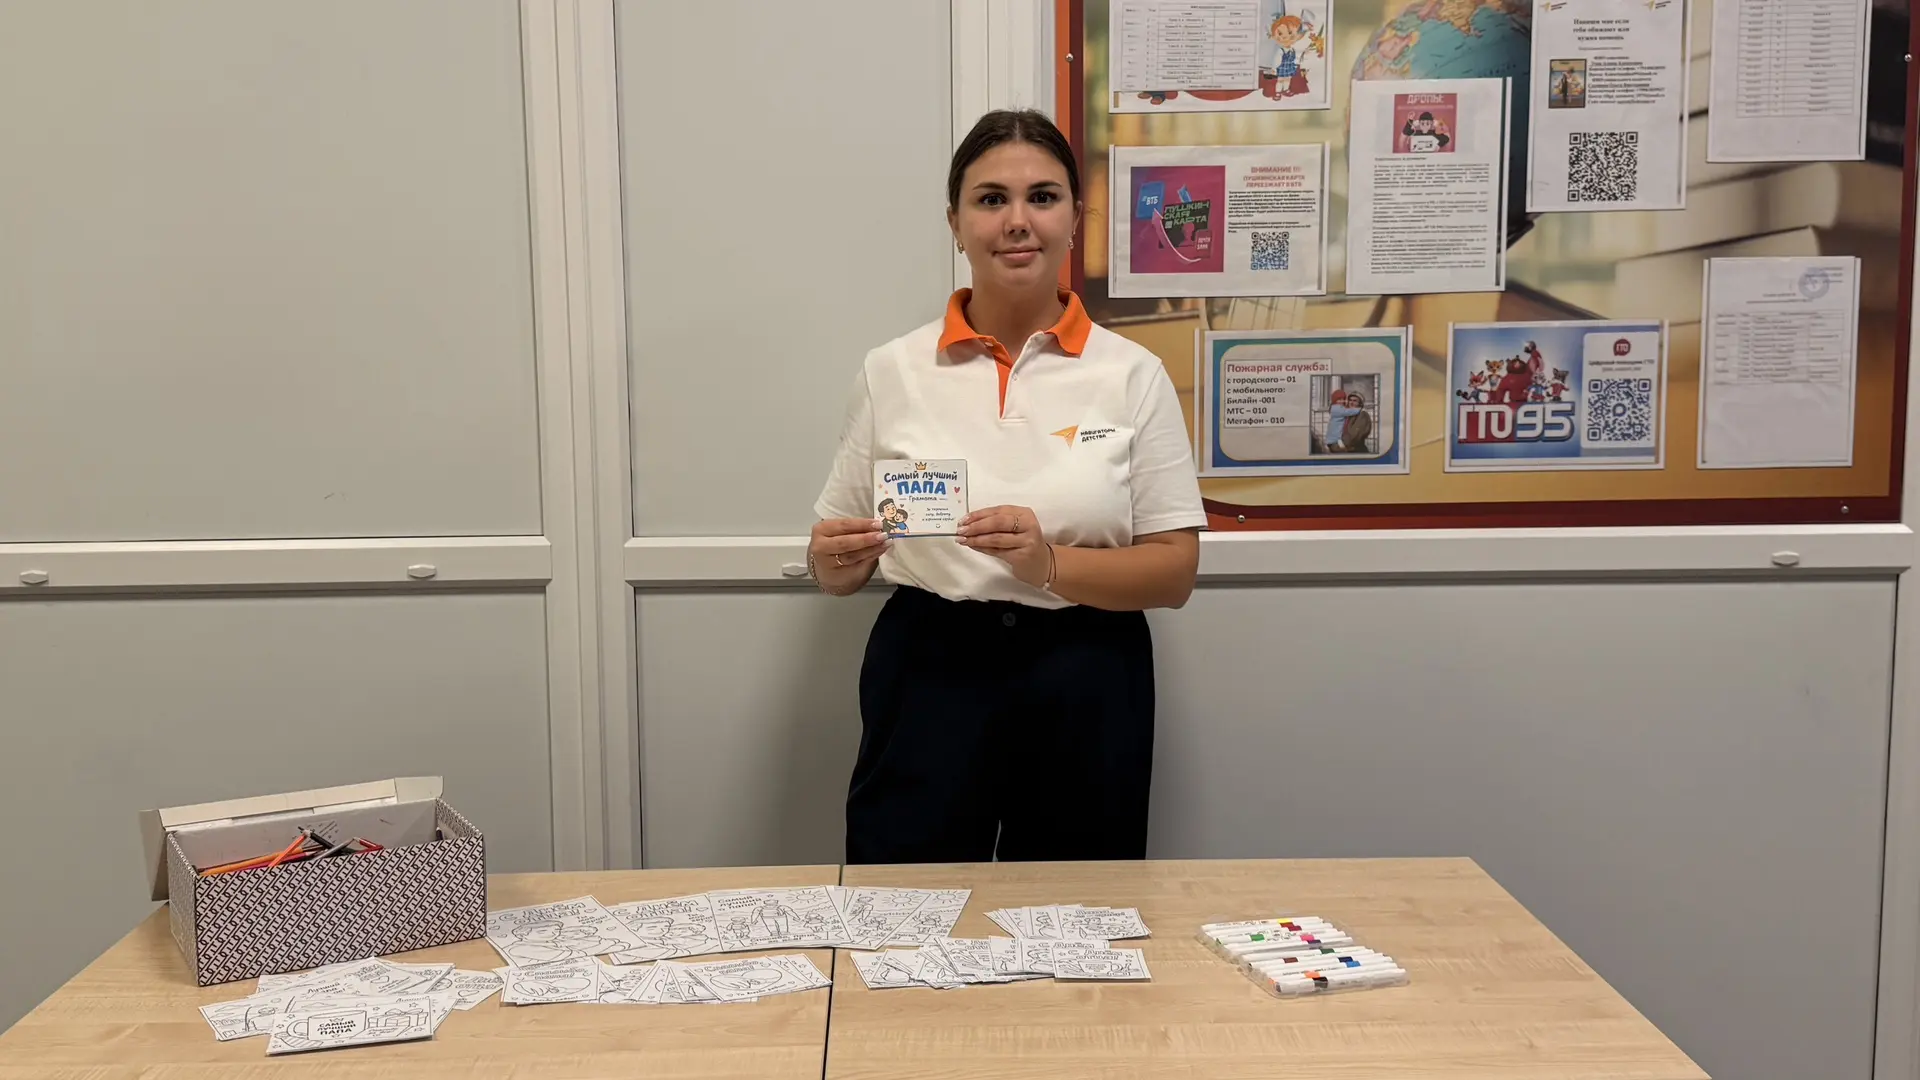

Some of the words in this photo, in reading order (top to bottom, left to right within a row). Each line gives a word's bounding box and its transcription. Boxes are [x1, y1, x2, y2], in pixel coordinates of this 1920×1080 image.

[1146, 195, 1158, 205] ВТБ
[1164, 211, 1190, 220] СКАЯ
[1173, 215, 1207, 225] КАРТА
[1227, 364, 1282, 374] Пожарная
[1285, 362, 1329, 374] служба:
[1233, 377, 1279, 385] городского
[1233, 386, 1286, 394] мобильного:
[884, 471, 919, 483] Самый
[922, 471, 957, 480] лучший
[897, 481, 946, 495] ПАПА
